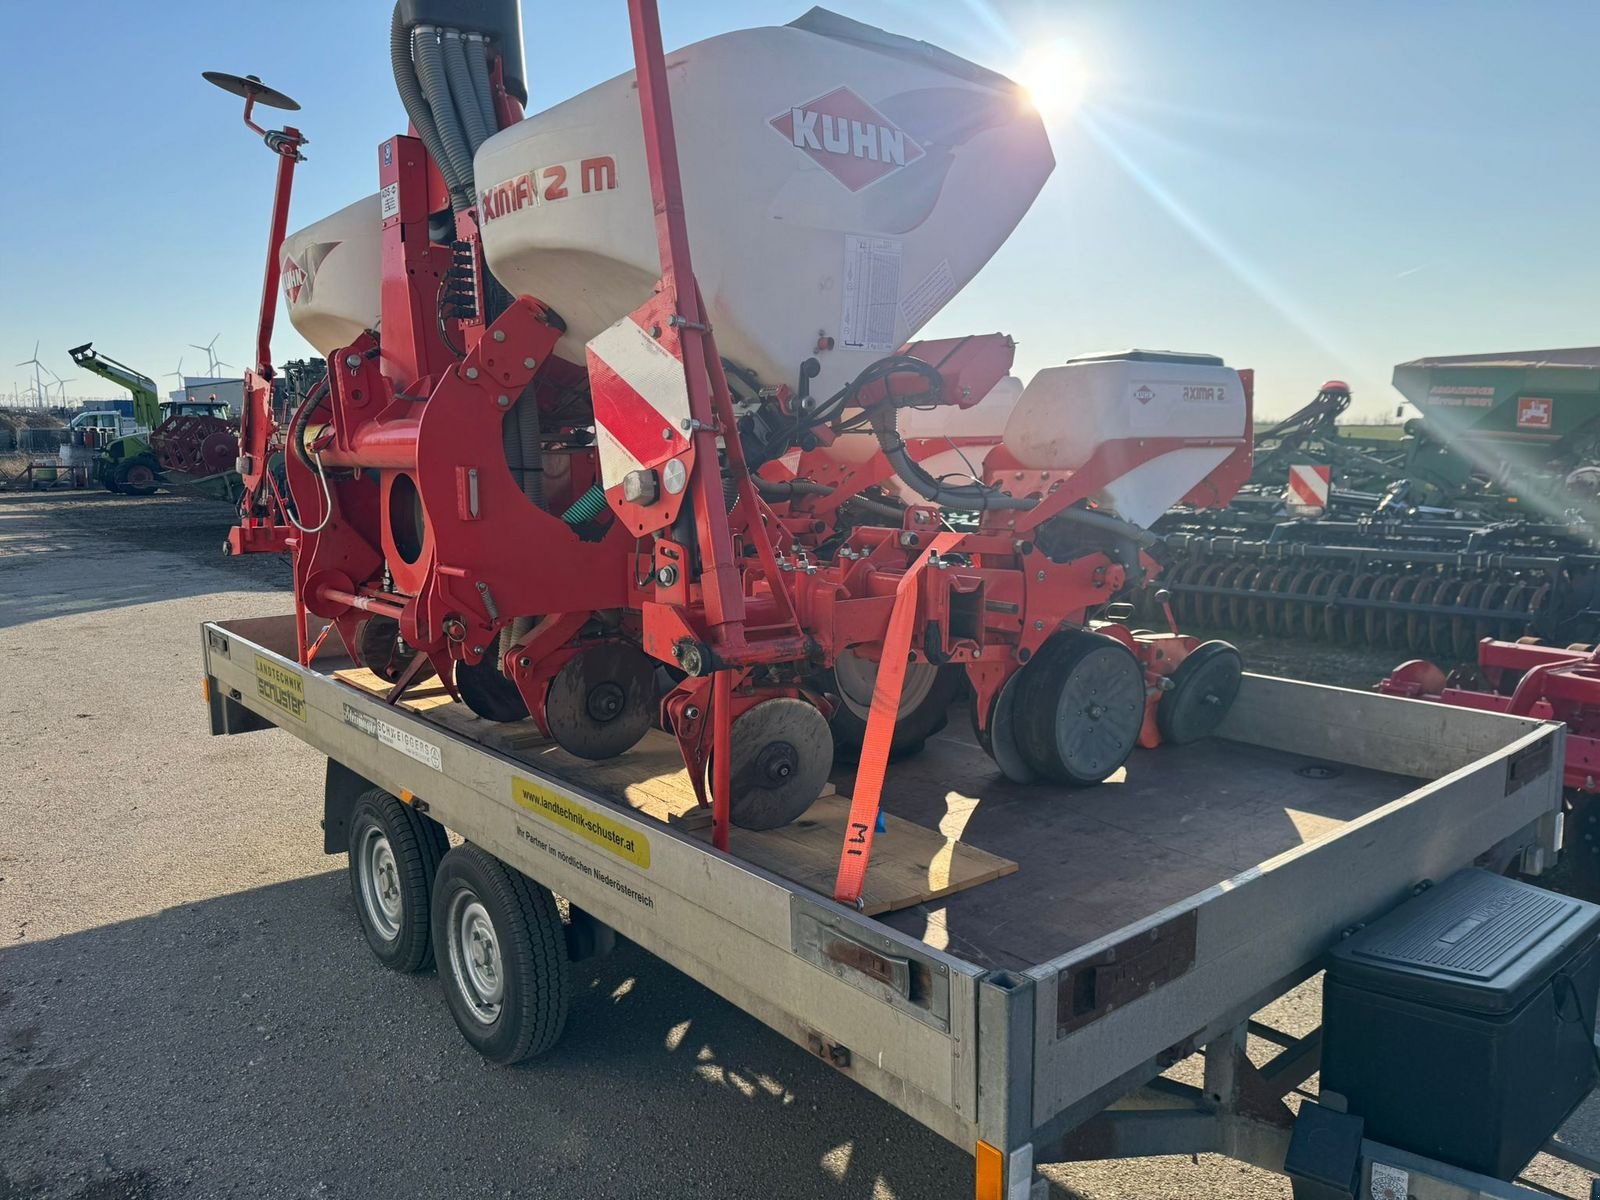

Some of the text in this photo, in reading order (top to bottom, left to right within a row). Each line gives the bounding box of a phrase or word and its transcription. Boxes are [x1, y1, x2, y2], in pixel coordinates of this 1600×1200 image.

[791, 107, 905, 167] KUHN
[483, 174, 534, 225] XIMA
[543, 165, 569, 201] 2
[1217, 387, 1225, 401] 2
[254, 658, 304, 692] LANDTECHNIK
[377, 720, 430, 756] SCHWEIGGERS
[522, 789, 635, 853] www.landtechnik-schuster.at
[516, 826, 654, 909] Ihr Partner im nördlichen Niederösterreich
